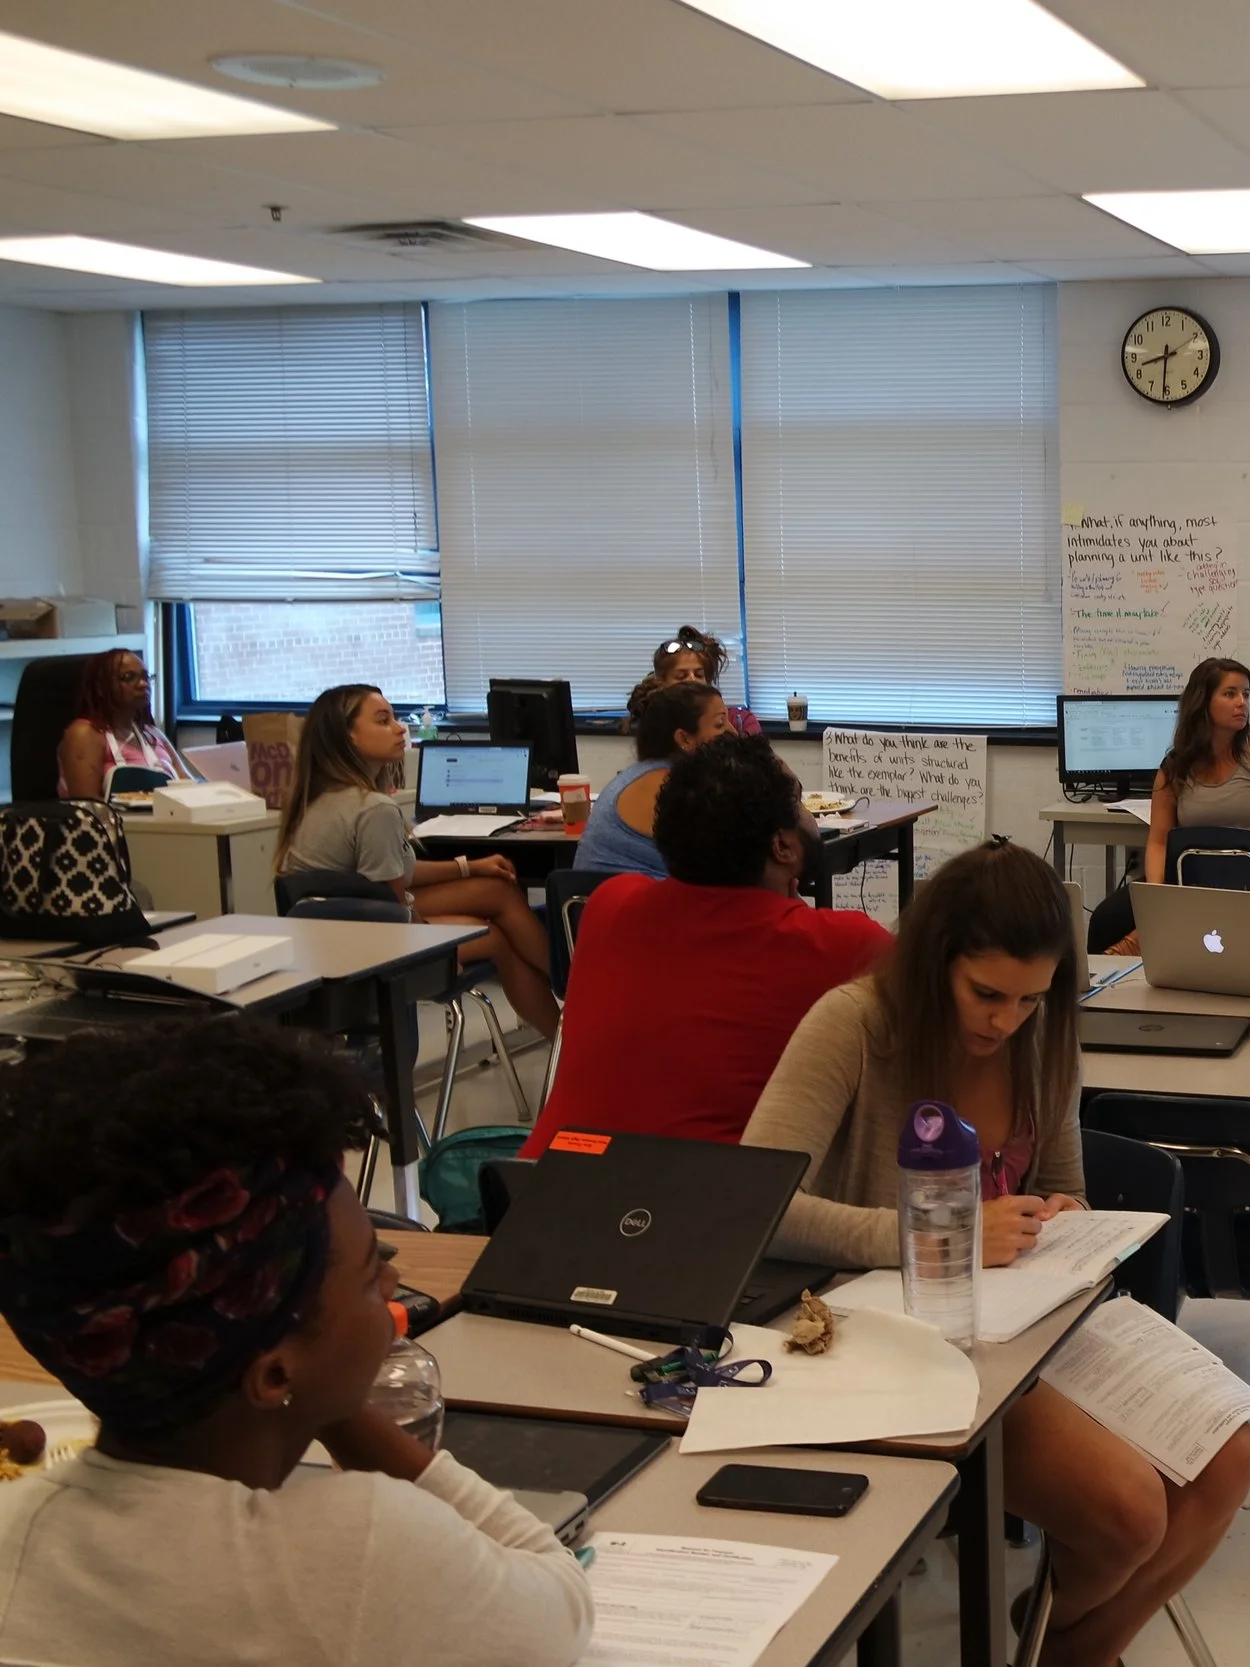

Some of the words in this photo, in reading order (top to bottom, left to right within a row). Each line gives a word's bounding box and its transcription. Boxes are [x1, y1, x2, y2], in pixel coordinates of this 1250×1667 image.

[1146, 320, 1154, 332] 11
[1161, 315, 1171, 327] 12
[1133, 334, 1143, 345] 10
[1131, 352, 1137, 363] 9
[1197, 350, 1203, 360] 3
[1136, 369, 1142, 379] 8
[1193, 367, 1199, 378] 4
[1148, 380, 1154, 391] 7
[1164, 385, 1170, 396] 6
[1181, 380, 1187, 390] 5
[1113, 513, 1124, 528] if
[1129, 514, 1182, 535] anything,
[1185, 515, 1217, 527] most
[1067, 533, 1131, 548] intimidates
[1139, 537, 1158, 552] you
[1163, 533, 1198, 548] about
[1068, 550, 1115, 569] planning
[1119, 554, 1126, 563] a
[1130, 549, 1154, 563] unit
[1160, 549, 1181, 563] like
[1185, 546, 1222, 563] this?
[835, 732, 860, 745] What
[862, 733, 874, 746] do
[879, 736, 898, 752] you
[899, 735, 928, 750] think
[934, 739, 949, 749] are
[952, 737, 977, 752] the
[828, 747, 867, 763] benefits
[873, 750, 883, 763] of
[889, 752, 916, 765] units
[921, 755, 969, 770] structured
[828, 765, 844, 779] like
[846, 765, 864, 779] the
[867, 767, 915, 783] exemplar?
[919, 770, 945, 785] What
[948, 772, 960, 785] do
[965, 778, 983, 791] you
[828, 781, 858, 795] think
[860, 786, 875, 797] are
[876, 783, 893, 798] the
[896, 785, 926, 804] biggest
[931, 789, 984, 810] challenges?
[624, 1217, 647, 1228] DELL
